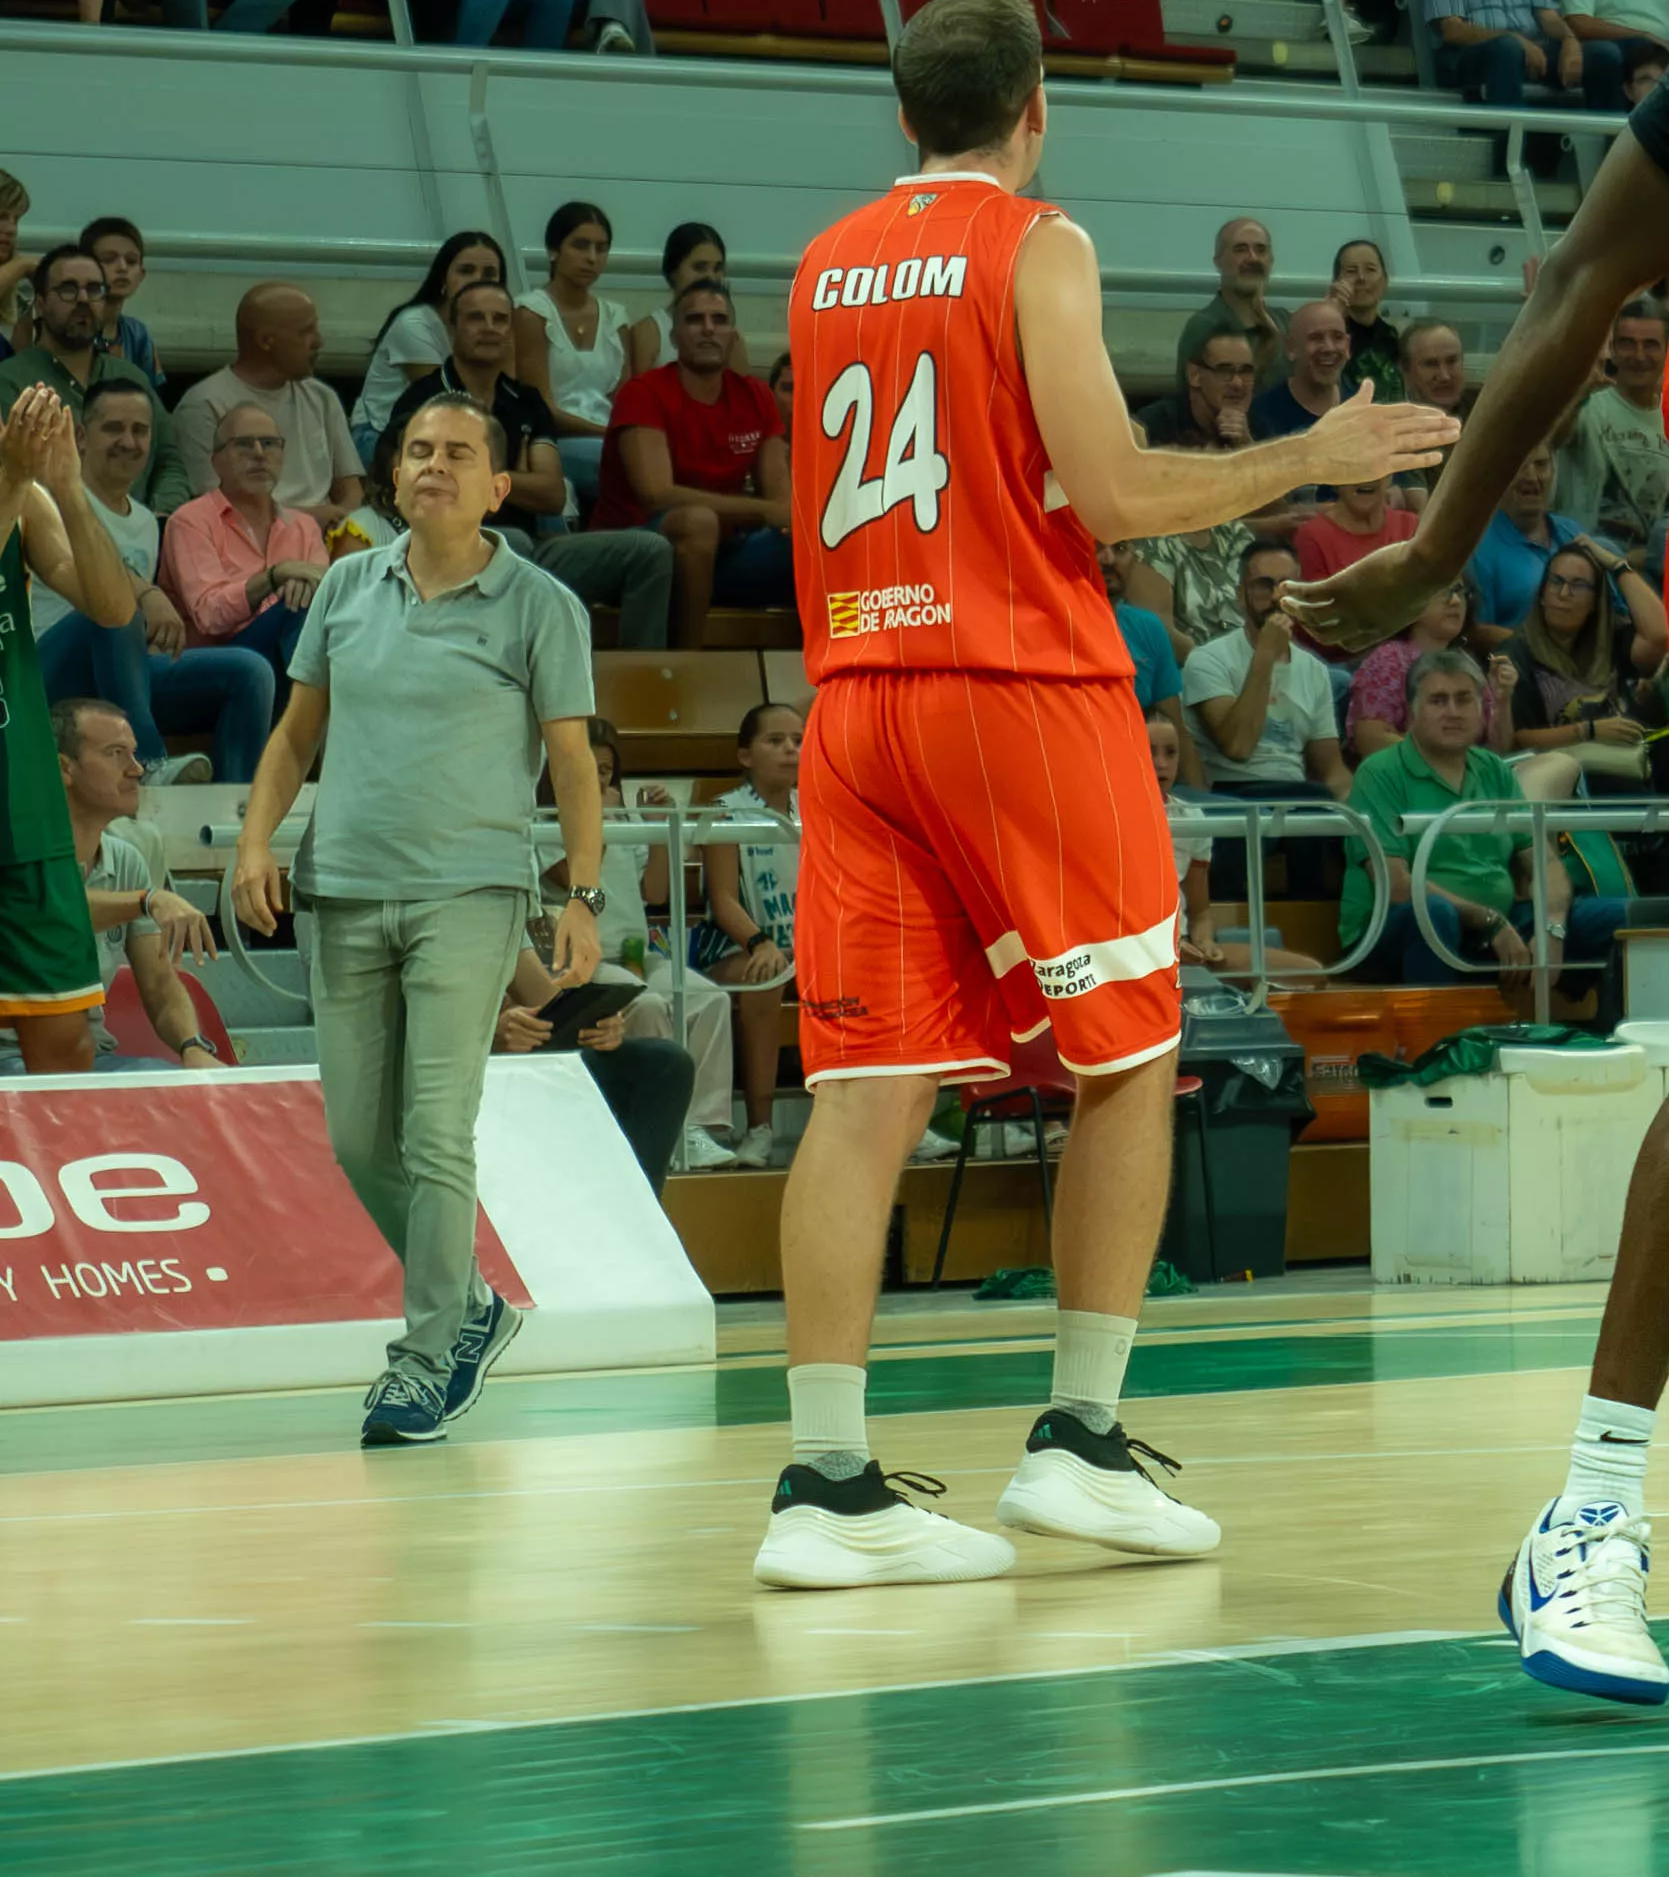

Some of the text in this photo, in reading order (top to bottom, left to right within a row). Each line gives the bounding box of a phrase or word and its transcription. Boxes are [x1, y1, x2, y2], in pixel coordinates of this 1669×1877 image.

[811, 254, 968, 311] COLOM
[820, 349, 950, 551] 24
[860, 611, 880, 634] DE
[39, 1257, 194, 1301] HOMES
